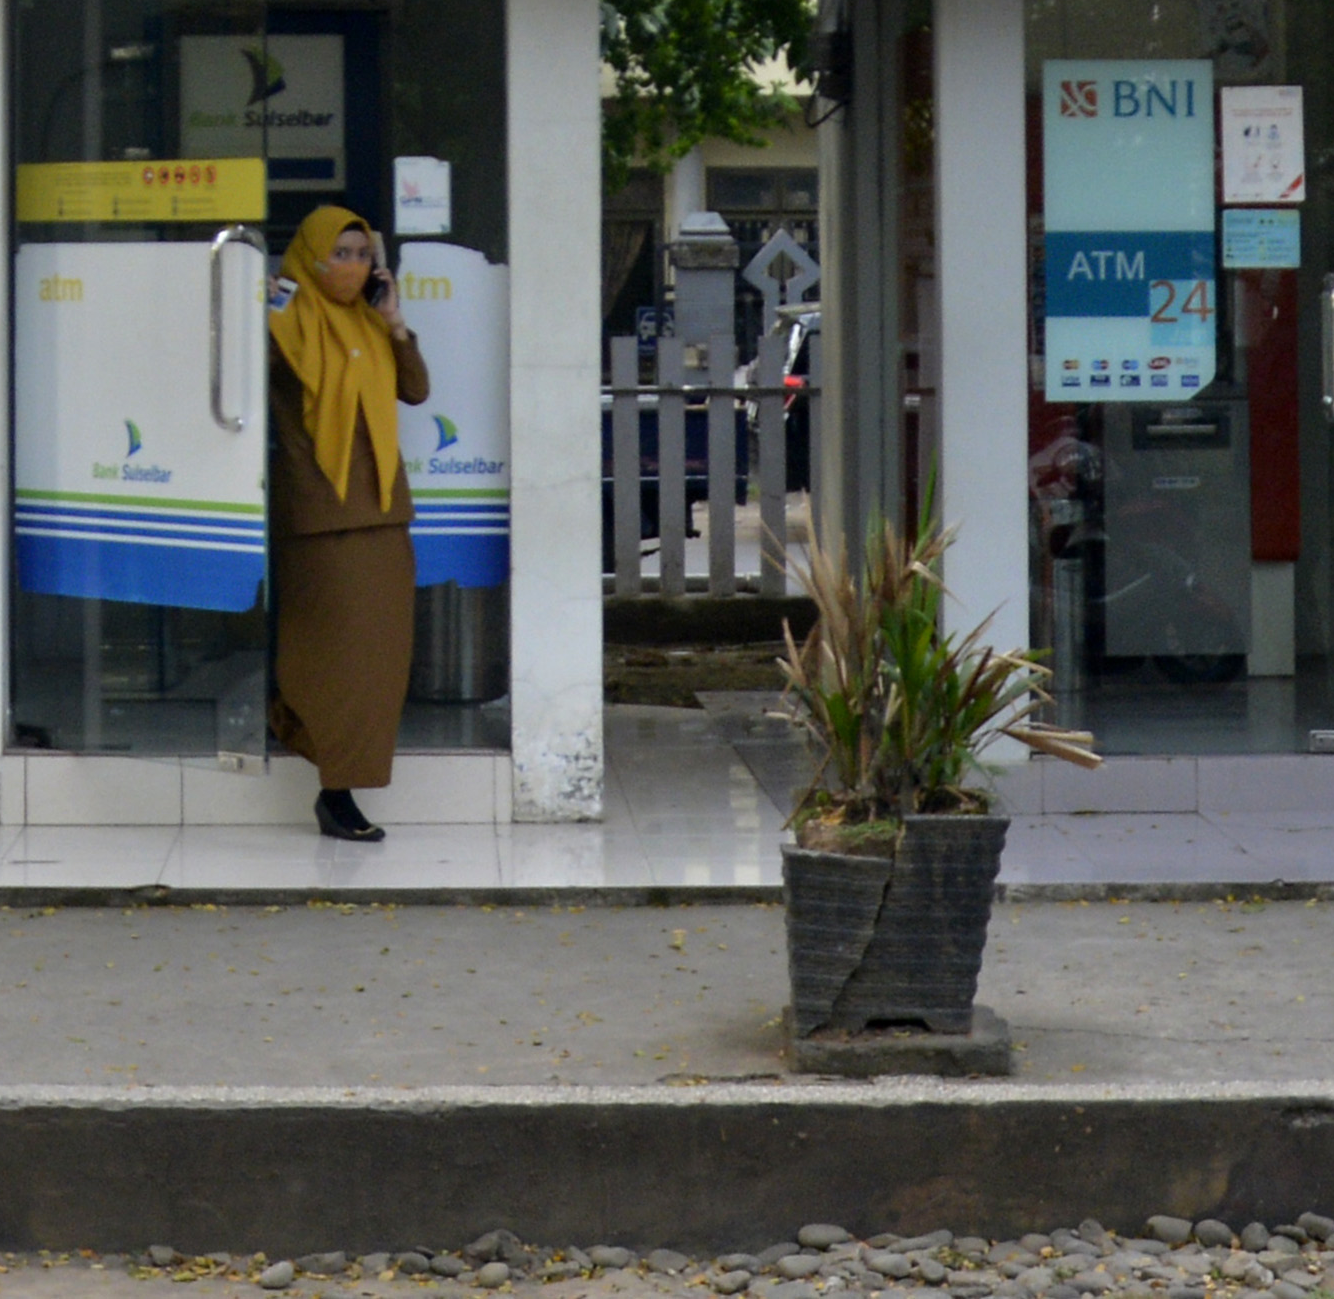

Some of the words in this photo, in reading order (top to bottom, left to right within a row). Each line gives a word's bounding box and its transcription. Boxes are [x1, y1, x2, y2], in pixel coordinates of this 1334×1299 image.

[1112, 80, 1195, 117] BNI
[1068, 251, 1145, 280] ATM
[39, 274, 84, 302] atm
[398, 271, 453, 300] tm
[1151, 280, 1215, 323] 24
[93, 462, 119, 479] Bank
[429, 457, 504, 474] Sulselbar
